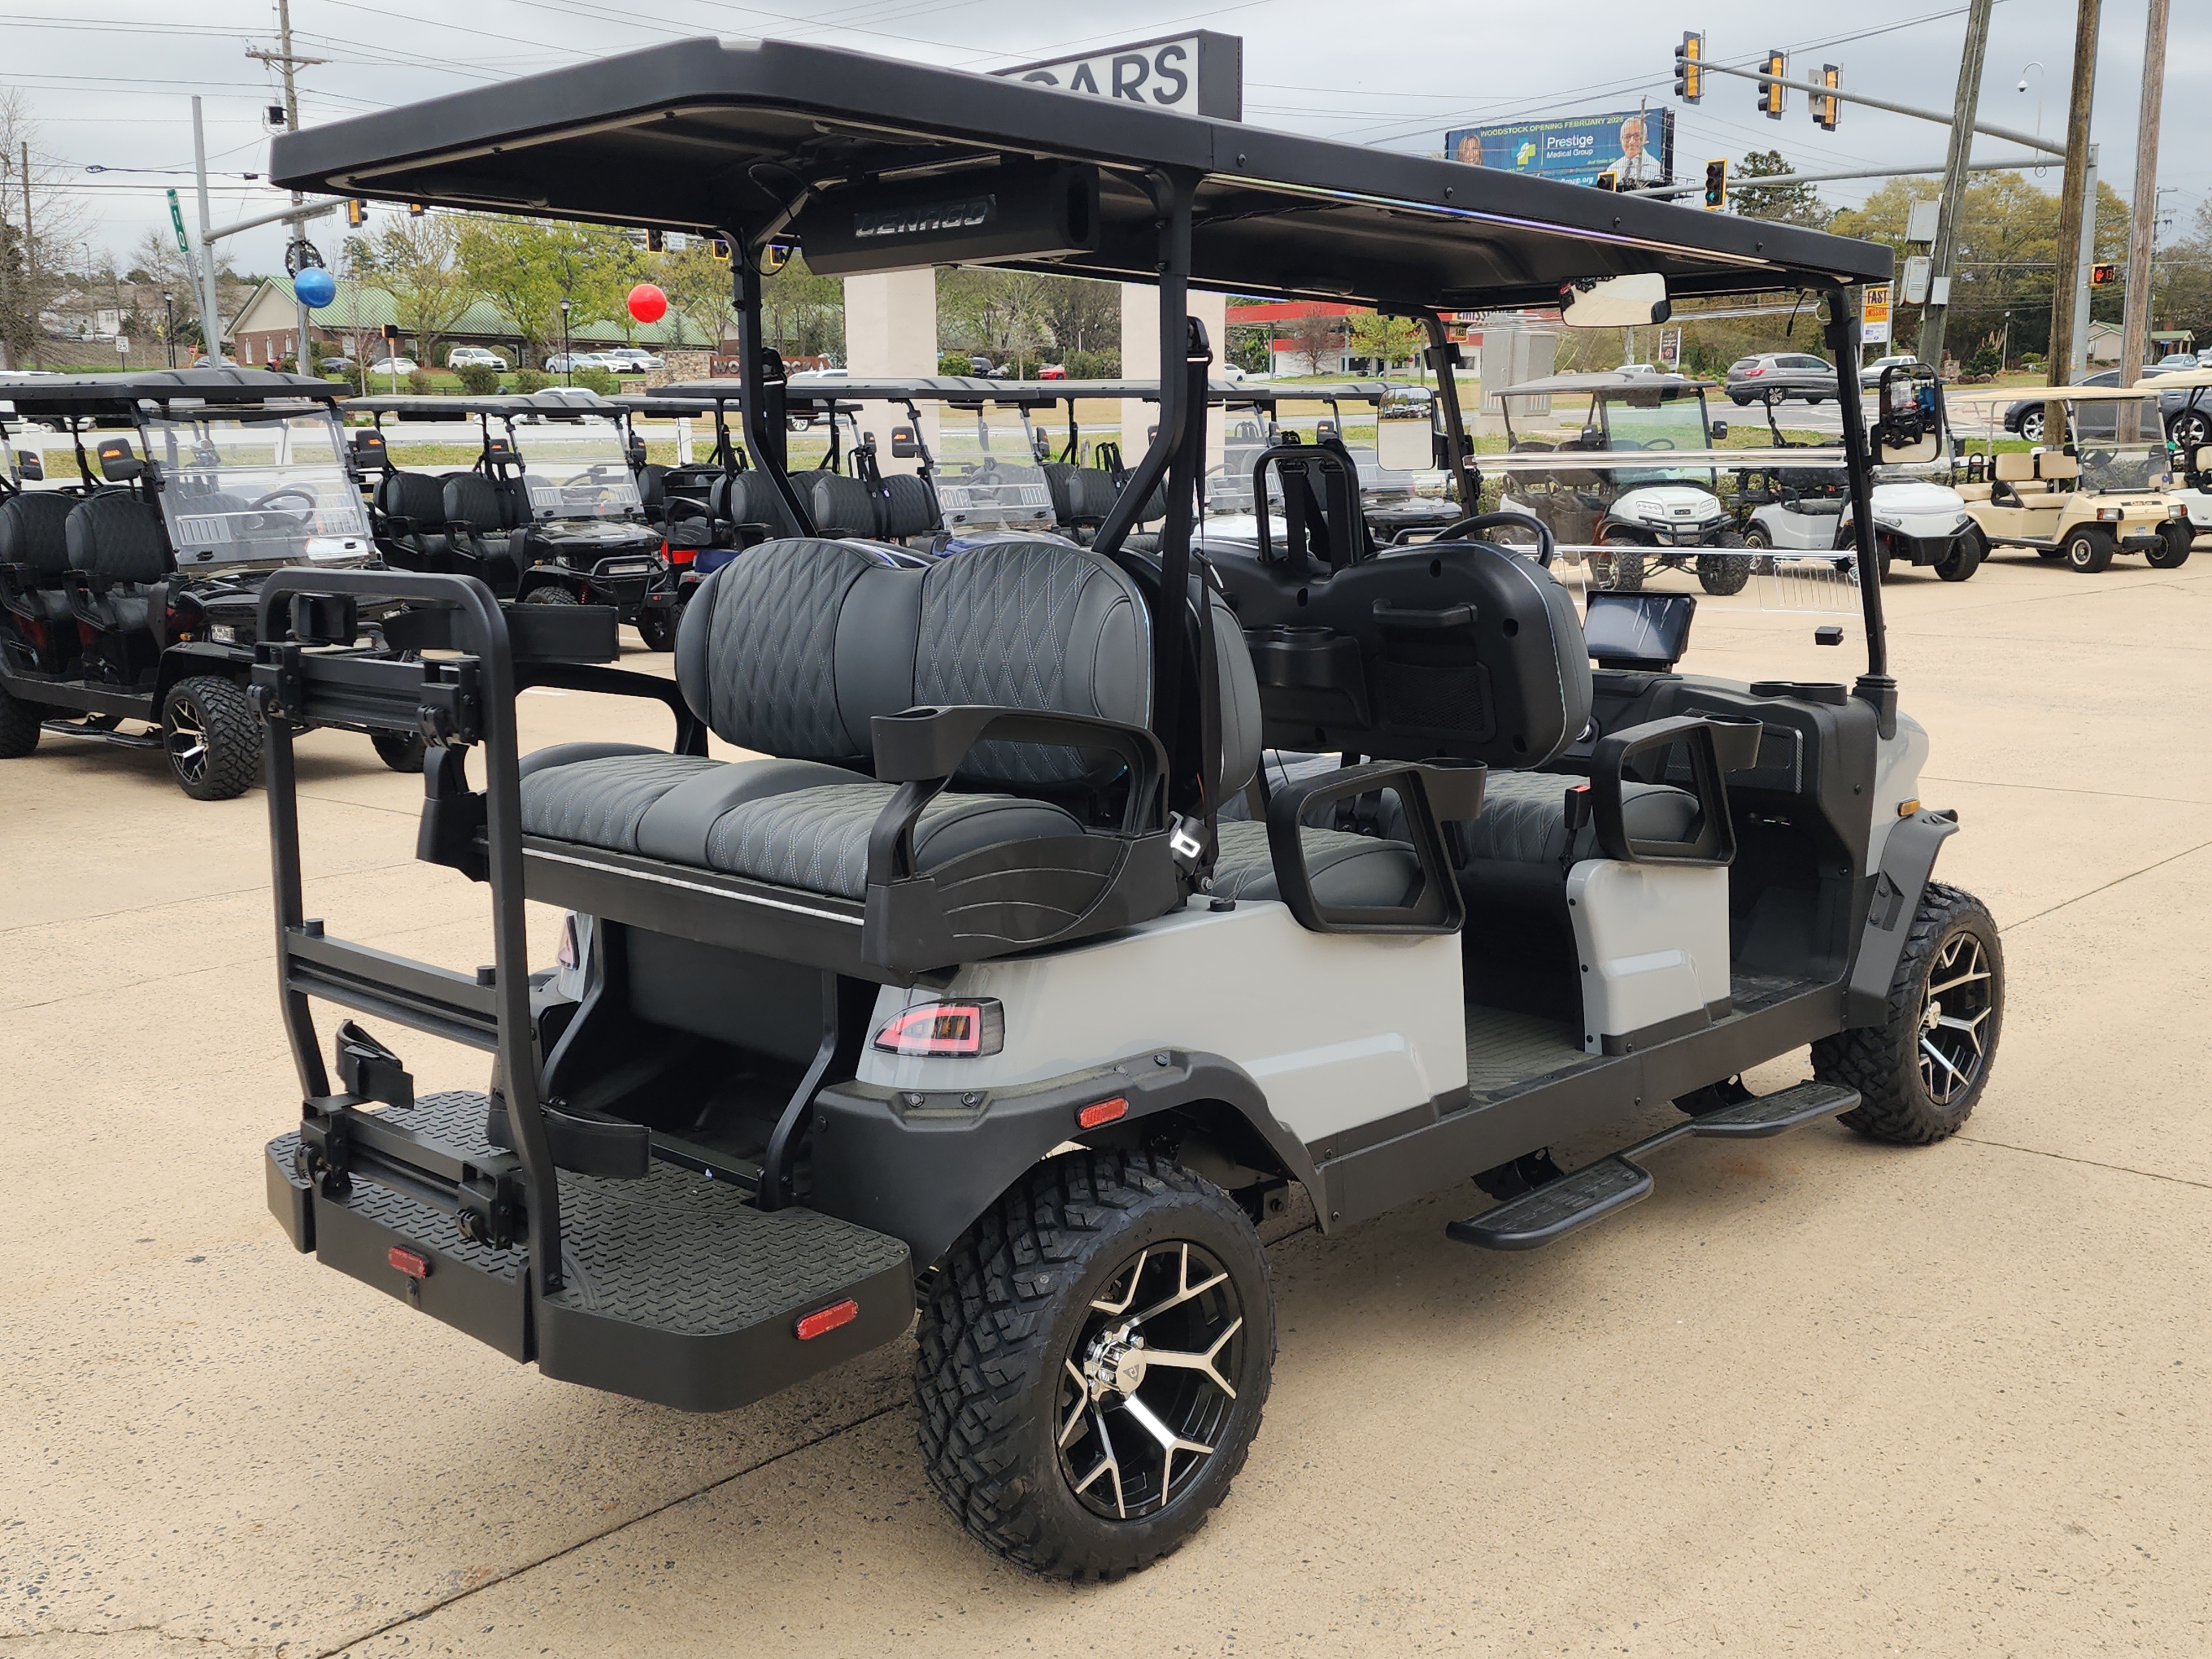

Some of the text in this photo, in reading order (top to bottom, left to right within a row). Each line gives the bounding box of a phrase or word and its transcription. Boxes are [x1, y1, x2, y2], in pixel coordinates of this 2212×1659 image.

[1022, 45, 1188, 104] ARS
[1480, 126, 1528, 137] WOODSTOCK
[1530, 122, 1563, 132] OPENING
[1564, 118, 1604, 128] FEBRUARY
[1548, 134, 1594, 148] Prestige
[1547, 149, 1572, 158] Medical
[1867, 291, 1887, 304] FAST
